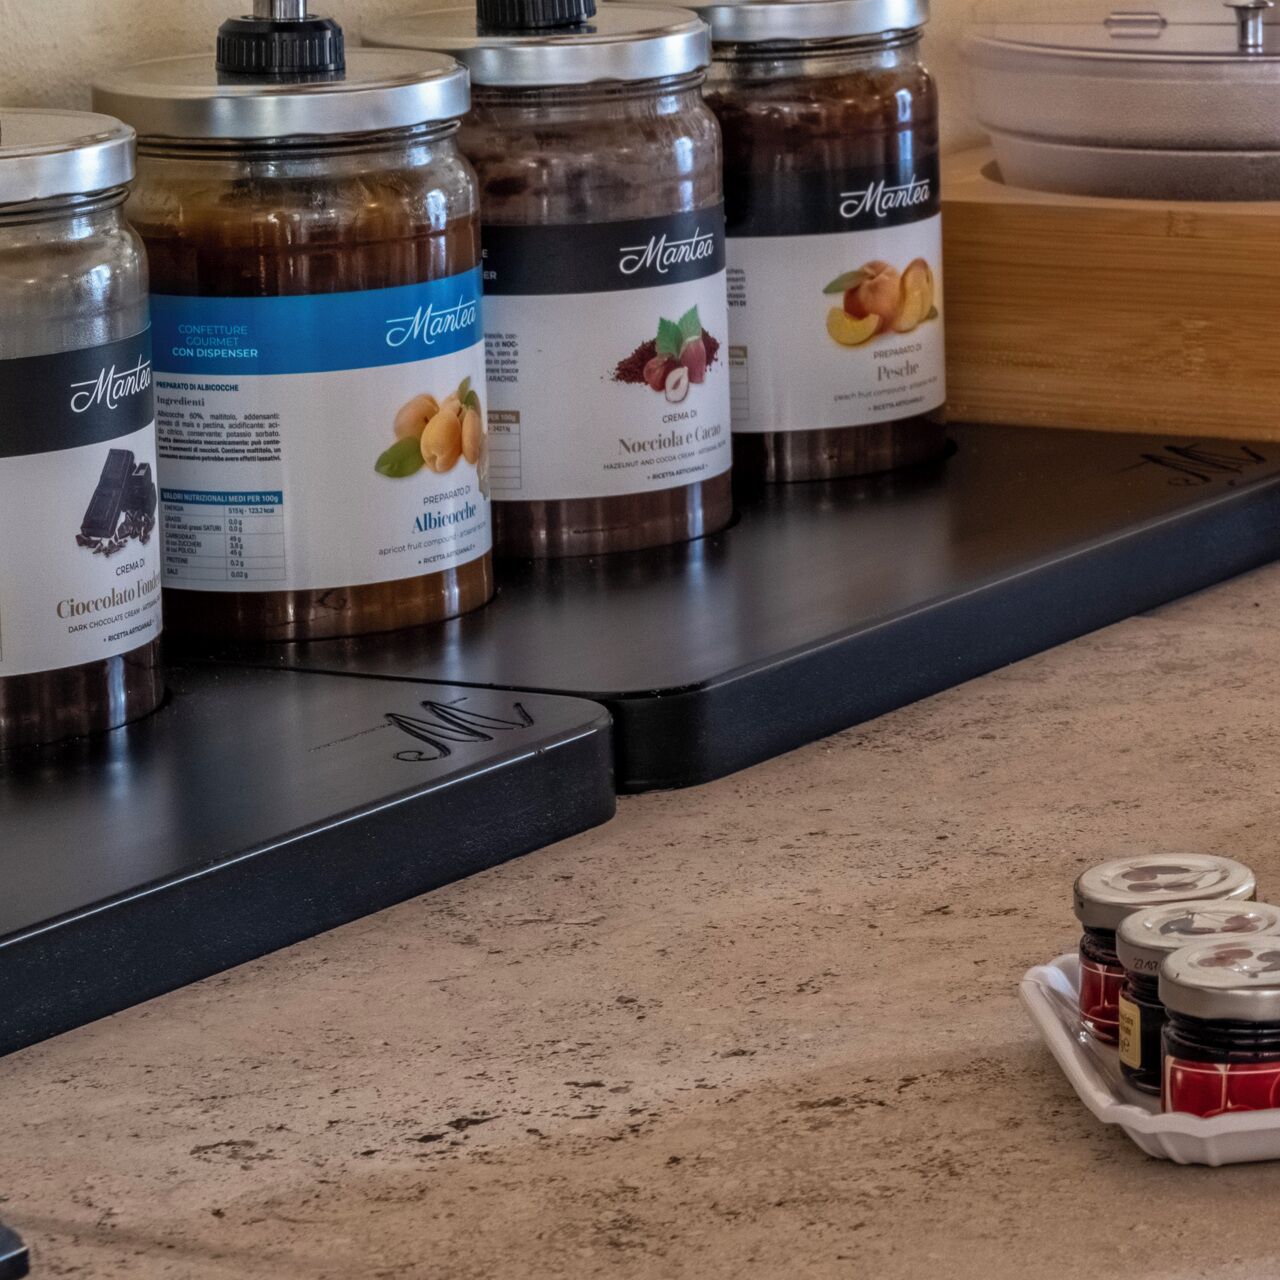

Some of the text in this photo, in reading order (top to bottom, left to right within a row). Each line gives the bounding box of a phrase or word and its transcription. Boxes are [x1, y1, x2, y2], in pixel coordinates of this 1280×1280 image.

[840, 174, 930, 218] Mantea
[618, 226, 714, 275] Mantea
[386, 294, 476, 347] Mantea
[178, 324, 248, 335] CONFETTURE
[185, 337, 239, 346] GOURMET
[172, 347, 258, 358] CON DISPENSER
[877, 360, 919, 381] Pesche
[70, 354, 150, 413] Mantea
[197, 384, 239, 392] ALBICOCCHE
[157, 395, 205, 408] Ingredienti
[661, 412, 689, 423] CREMA
[618, 424, 721, 455] Nocciola e Cacao
[603, 461, 639, 470] HAZELNUT
[656, 455, 676, 463] COCOA
[652, 471, 675, 480] RICETTA
[248, 495, 261, 503] PER
[423, 485, 471, 506] PREPARATO DI
[411, 501, 476, 535] Albicocche
[378, 545, 406, 556] apricot
[407, 541, 422, 550] fruit
[423, 553, 446, 564] RICETTA
[115, 561, 139, 577] CREMA
[56, 587, 135, 619] Cioccolato
[68, 625, 88, 634] DARK
[89, 613, 123, 629] CHOCOLATE
[108, 631, 129, 642] RICETTA
